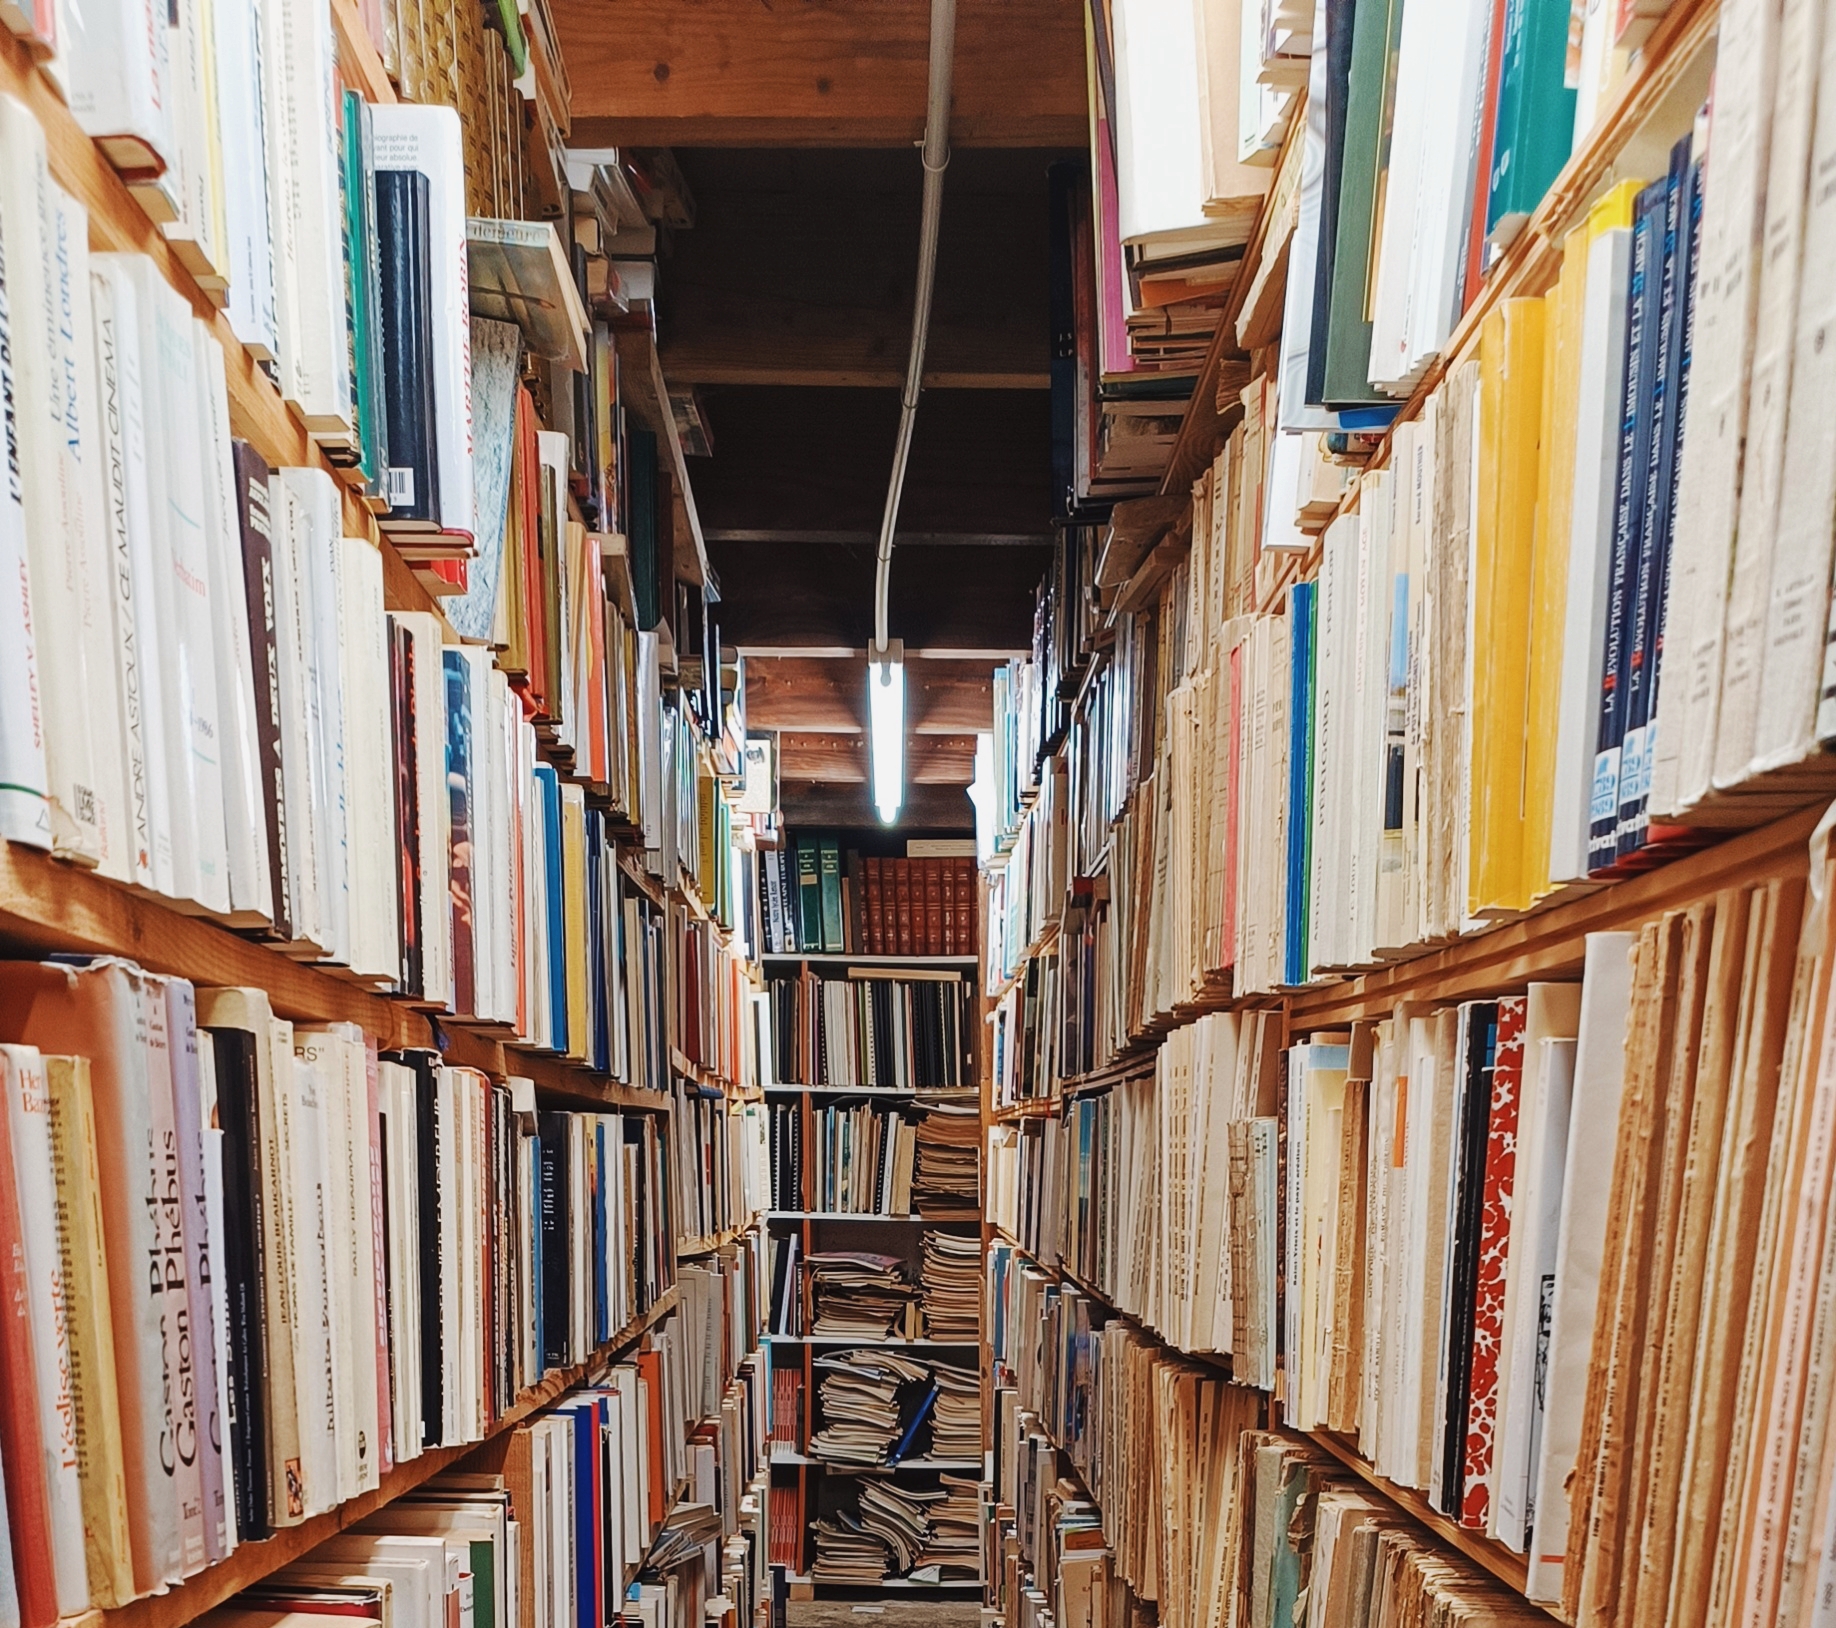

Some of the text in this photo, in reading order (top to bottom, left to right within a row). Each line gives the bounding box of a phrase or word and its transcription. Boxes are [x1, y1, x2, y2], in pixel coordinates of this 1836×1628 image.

[40, 225, 58, 361] éminence
[1657, 285, 1671, 306] ET
[1659, 258, 1673, 280] LA
[53, 206, 81, 464] Albert Londres
[458, 231, 474, 457] MARTHE ROBIN
[1651, 309, 1670, 396] LIMOUSIN
[48, 368, 63, 424] Une
[1651, 397, 1663, 420] LE
[1603, 215, 1651, 714] LA REVOLUTION FRANÇAISE DANS LE LIMOUSIN ET LA MARCHE
[1647, 422, 1661, 466] DANS
[1639, 469, 1658, 557] FRANÇAISE
[101, 318, 149, 841] ANDRE ASTOUX CE MAUDIT CINEMA
[260, 555, 273, 633] VOIX
[1631, 560, 1650, 668] REVOLUTION
[17, 556, 43, 750] SHELLEY ASHLEY
[266, 643, 281, 729] DEUX
[1630, 670, 1642, 692] LA
[1317, 689, 1332, 827] PÉRIGORD
[50, 1268, 67, 1351] verte
[160, 1129, 197, 1469] Gaston Phébus
